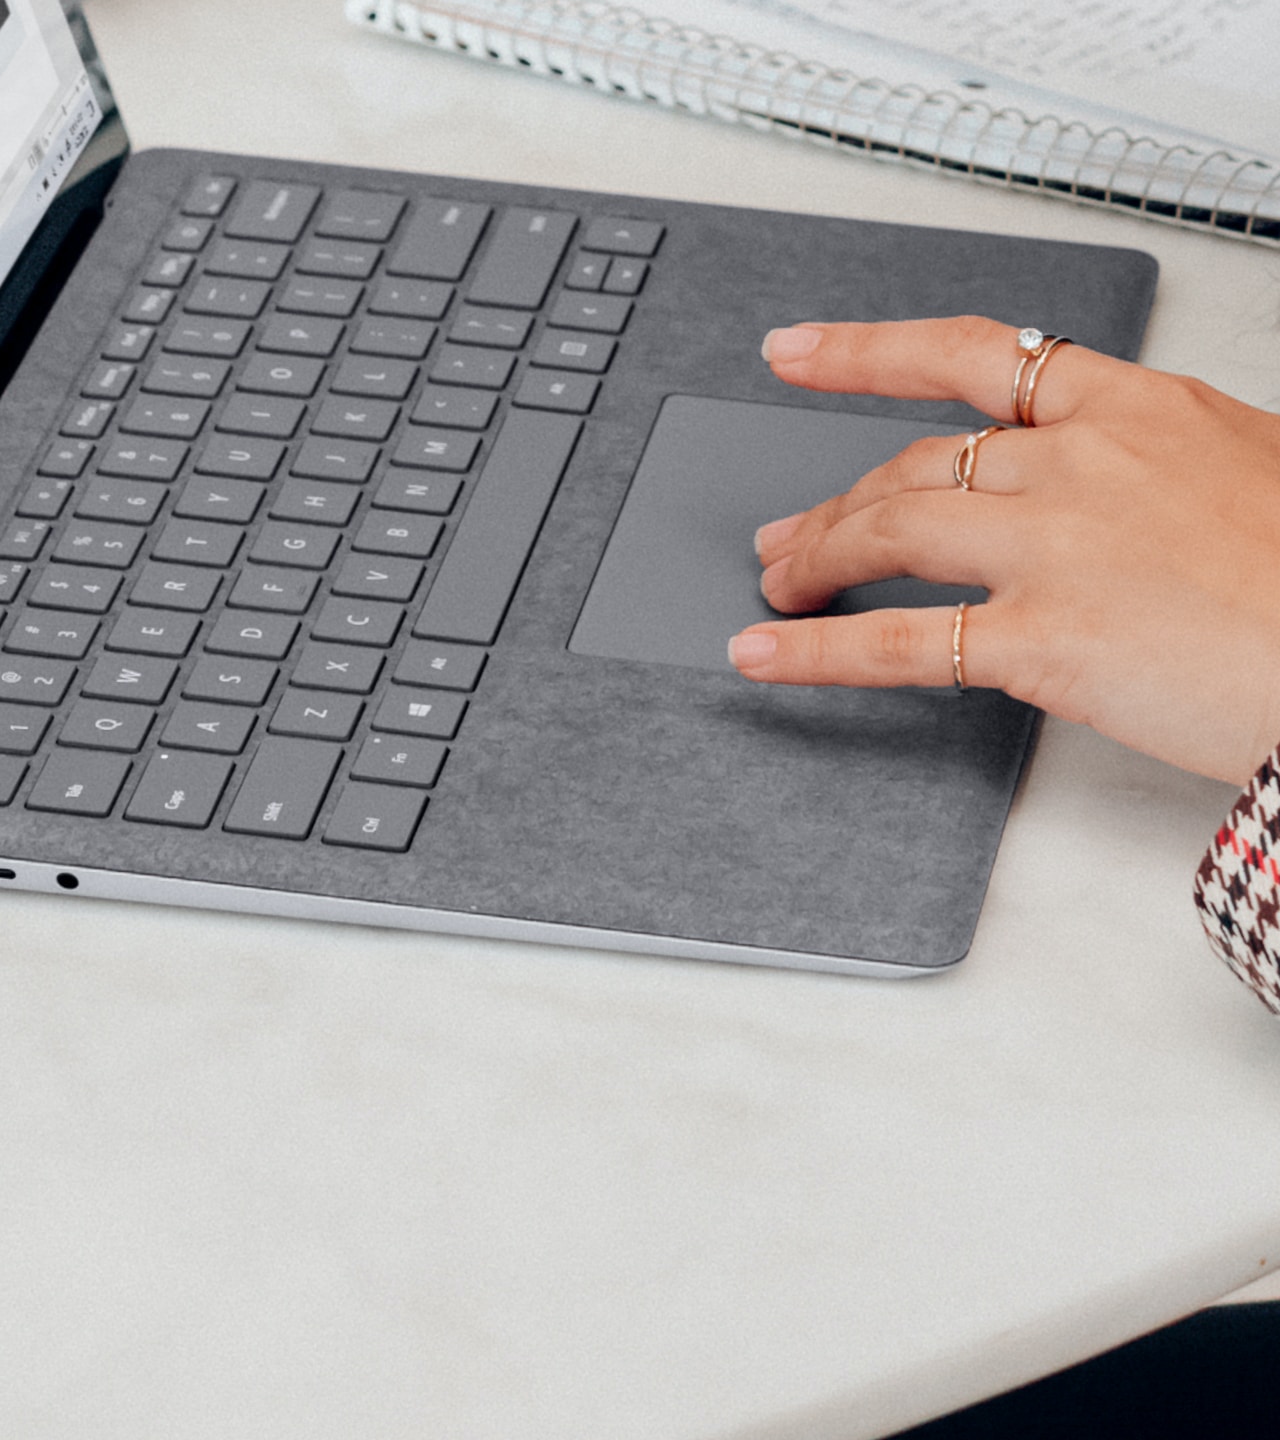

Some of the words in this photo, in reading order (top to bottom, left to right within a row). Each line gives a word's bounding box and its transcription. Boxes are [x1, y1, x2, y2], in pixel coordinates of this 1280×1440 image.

[1, 671, 21, 683] @
[73, 536, 92, 545] %
[34, 677, 53, 685] 2
[83, 585, 100, 593] 4
[192, 372, 211, 380] 9
[65, 784, 83, 797] Tab
[95, 719, 122, 730] Q
[117, 669, 141, 682] W
[141, 627, 164, 635] E
[164, 581, 186, 590] R
[186, 537, 207, 545] T
[208, 493, 229, 501] Y
[229, 450, 251, 461] U
[270, 368, 292, 379] O
[290, 329, 308, 338] P
[165, 791, 184, 809] Caps
[197, 722, 219, 732] A
[219, 675, 241, 683] S
[240, 628, 262, 638] D
[263, 584, 283, 592] F
[284, 539, 306, 549] G
[304, 496, 325, 506] H
[345, 413, 366, 421] K
[263, 802, 283, 821] Shift
[304, 708, 327, 718] Z
[326, 661, 349, 672] X
[347, 615, 369, 625] C
[366, 571, 388, 580] V
[387, 528, 408, 537] B
[406, 485, 428, 495] N
[424, 441, 447, 454] M
[362, 817, 380, 832] Ctrl
[391, 753, 407, 763] Fn
[431, 658, 447, 670] Alt
